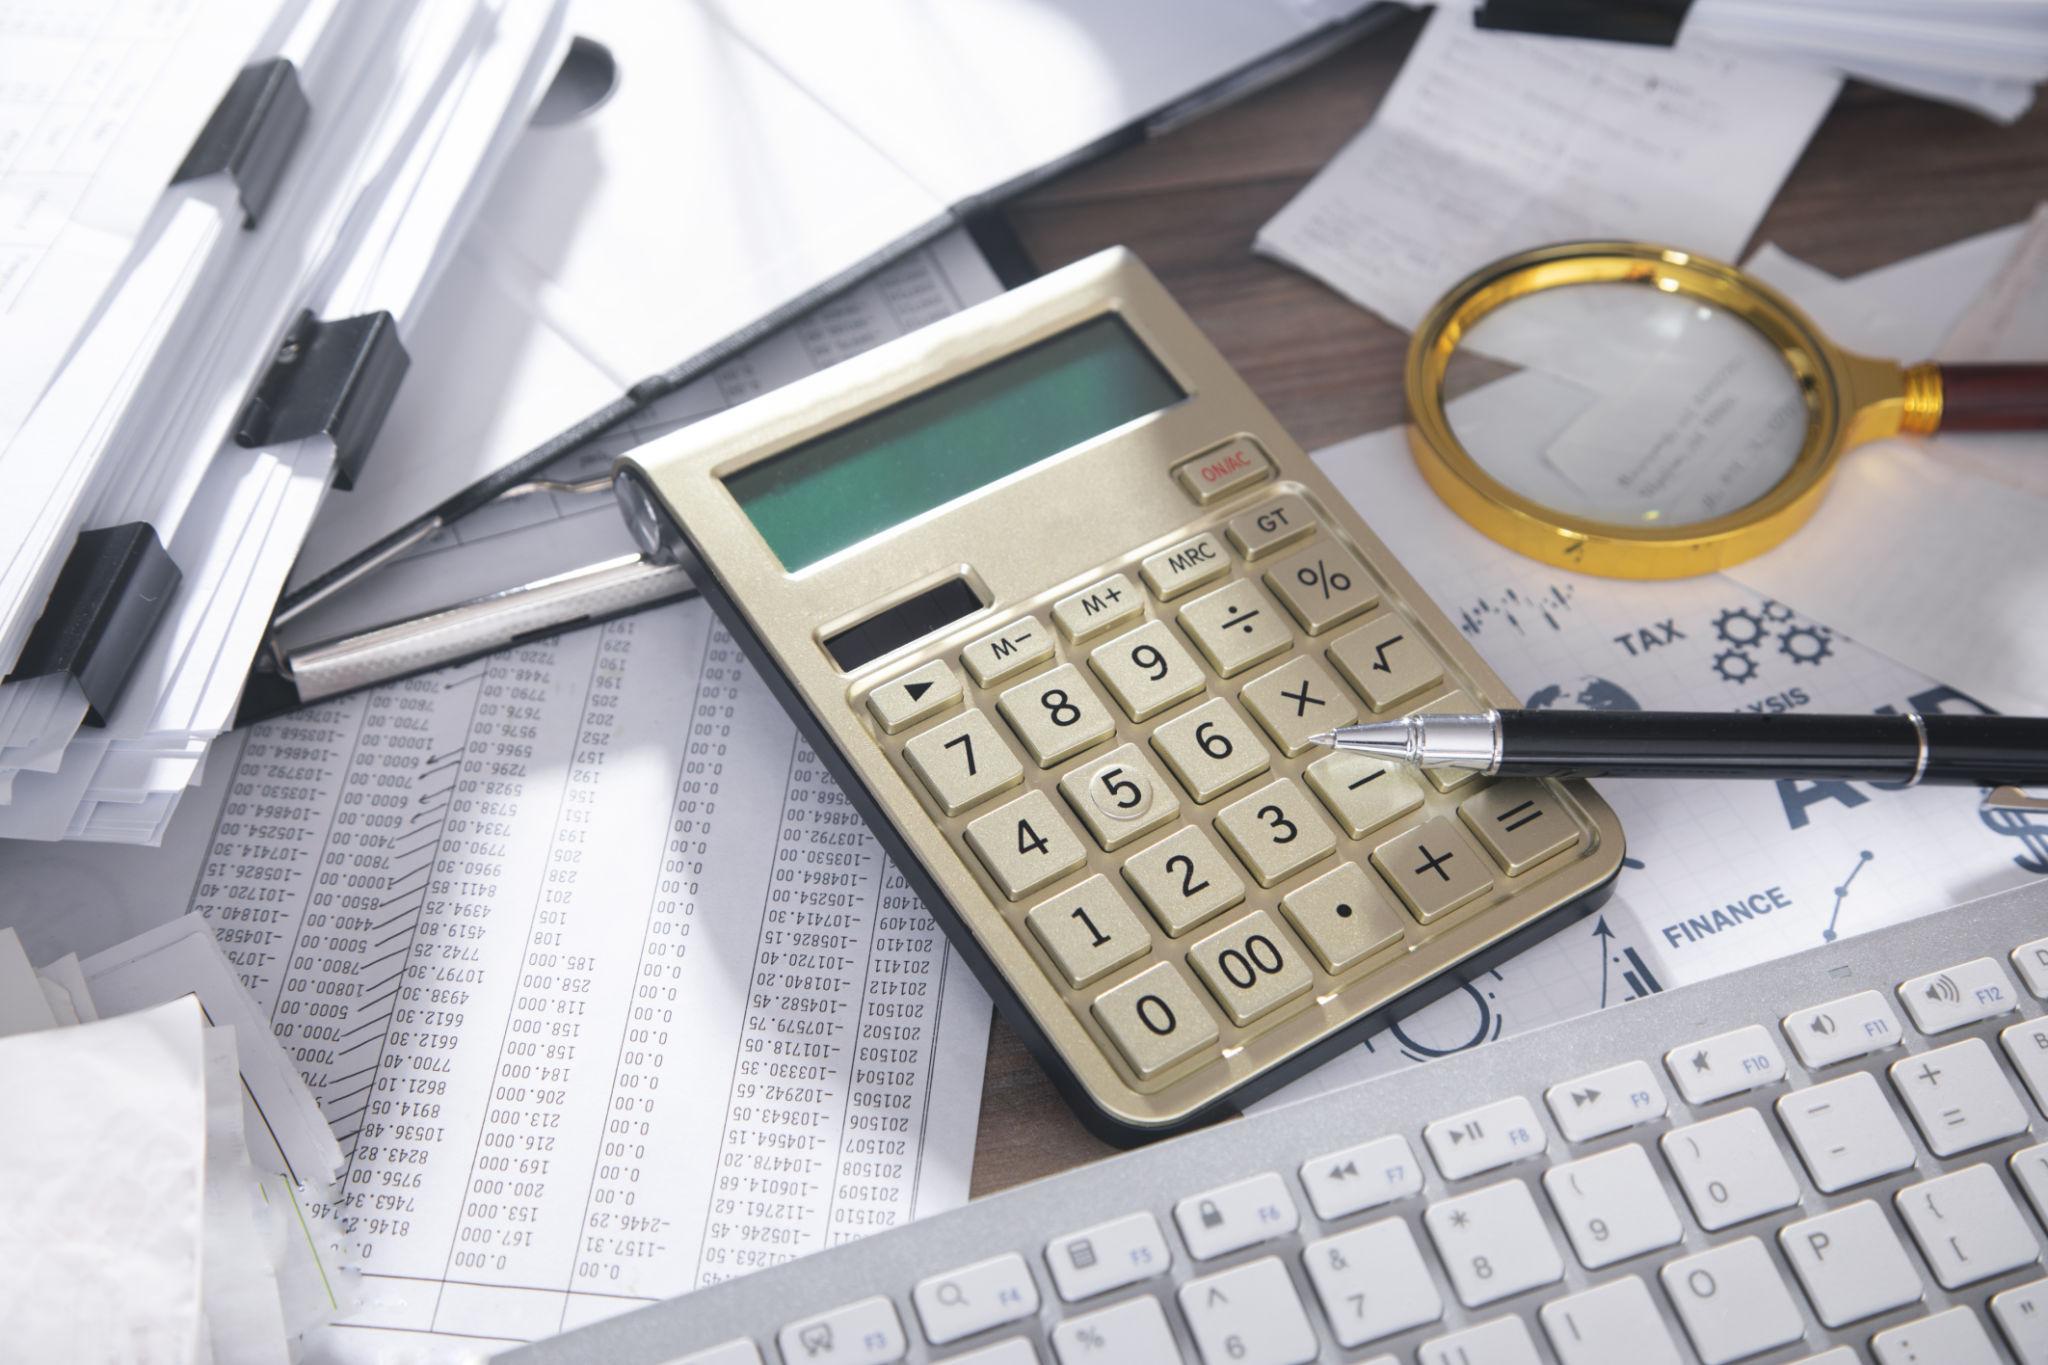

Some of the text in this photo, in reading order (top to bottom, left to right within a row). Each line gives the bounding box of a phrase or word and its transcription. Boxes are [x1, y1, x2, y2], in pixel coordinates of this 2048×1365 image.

[1200, 451, 1251, 484] ON/AC
[1256, 509, 1288, 533] GT
[1168, 542, 1216, 574] MRC
[1297, 560, 1351, 599] %
[1081, 586, 1122, 616] M+
[1614, 619, 1688, 658] TAX
[1131, 644, 1168, 681] 9
[1040, 689, 1082, 727] 8
[694, 723, 730, 737] 0.00
[1196, 722, 1233, 760] 6
[943, 734, 978, 777] 7
[1100, 768, 1142, 809] 5
[678, 800, 715, 814] 0.00
[1257, 805, 1298, 843] 3
[1017, 819, 1049, 854] 4
[670, 839, 706, 854] 0.00
[780, 849, 871, 866] -103530.00
[776, 869, 867, 887] -104864.00
[1165, 854, 1209, 897] 2
[431, 880, 497, 897] 8411.85
[773, 890, 864, 908] -105254.00
[426, 902, 491, 918] 4394.25
[769, 910, 861, 928] -107414.30
[1662, 886, 1793, 949] FINANCE
[307, 914, 373, 932] 4400.00
[420, 922, 486, 938] 4519.80
[653, 921, 689, 936] 0.00
[880, 917, 935, 931] 201409
[1070, 907, 1111, 947] 1
[300, 935, 367, 953] 5000.00
[765, 931, 857, 949] -105826.15
[877, 938, 933, 952] 201410
[415, 944, 479, 961] 7742.25
[761, 951, 854, 970] -101720.40
[1218, 934, 1284, 988] 00
[294, 956, 360, 975] 7800.00
[528, 953, 596, 971] 185.000
[874, 959, 930, 974] 201411
[408, 965, 485, 983] 10797.30
[757, 973, 850, 992] -101840.20
[287, 978, 364, 997] 10800.00
[523, 975, 591, 993] 258.000
[870, 981, 927, 995] 201412
[402, 987, 470, 1004] 4938.30
[753, 994, 847, 1013] -104582.45
[1976, 986, 2004, 1005] F12
[280, 1000, 348, 1019] 5000.00
[518, 997, 586, 1014] 118.000
[868, 1002, 923, 1018] 201501
[396, 1009, 464, 1027] 6612.30
[1136, 994, 1176, 1036] 0
[274, 1023, 341, 1041] 7000.00
[512, 1019, 581, 1037] 158.000
[749, 1016, 844, 1035] -107579.75
[863, 1024, 921, 1040] 201502
[1864, 1020, 1888, 1036] F11
[390, 1032, 458, 1049] 6612.30
[629, 1029, 668, 1045] 0.00
[507, 1041, 576, 1059] 158.000
[745, 1039, 840, 1058] -101718.05
[860, 1048, 918, 1063] 201503
[383, 1054, 450, 1072] 7700.40
[741, 1061, 837, 1081] -103330.35
[1743, 1055, 1770, 1073] F10
[501, 1064, 571, 1082] 184.000
[856, 1070, 915, 1086] 201504
[378, 1078, 446, 1095] 8621.10
[737, 1083, 833, 1103] -102942.65
[496, 1087, 566, 1105] 206.000
[615, 1096, 654, 1113] 0.00
[853, 1093, 912, 1109] 201505
[1630, 1090, 1651, 1108] F9
[372, 1101, 440, 1118] 8914.05
[732, 1106, 829, 1126] -103643.05
[491, 1110, 560, 1128] 213.000
[850, 1115, 909, 1132] 201506
[364, 1123, 445, 1142] 10536.48
[729, 1130, 826, 1150] -104564.15
[1509, 1127, 1530, 1146] F8
[485, 1133, 555, 1151] 216.000
[846, 1139, 905, 1155] 201507
[358, 1146, 428, 1164] 8243.82
[724, 1152, 822, 1172] -104478.20
[479, 1156, 550, 1174] 169.000
[842, 1162, 902, 1178] 201508
[352, 1169, 422, 1188] 9756.00
[1386, 1166, 1405, 1184] F7
[473, 1179, 544, 1198] 200.000
[719, 1176, 819, 1196] -106014.68
[839, 1185, 899, 1202] 201509
[346, 1193, 415, 1212] 7463.34
[595, 1189, 635, 1205] 0.00
[467, 1203, 539, 1222] 153.000
[715, 1198, 815, 1220] -112761.62
[835, 1208, 896, 1225] 201510
[1258, 1205, 1280, 1223] F6
[590, 1213, 670, 1233] -2446.29
[1589, 1219, 1609, 1241] 9
[461, 1227, 533, 1247] 167.000
[711, 1223, 811, 1244] -105246.45
[586, 1237, 665, 1257] -1157.31
[1808, 1232, 1831, 1260] P
[455, 1251, 507, 1270] 0.000
[1130, 1248, 1152, 1266] F5
[1329, 1249, 1348, 1270] &
[579, 1262, 620, 1280] 0.00
[1472, 1256, 1492, 1279] 8
[1000, 1288, 1020, 1307] F4
[1348, 1294, 1366, 1319] 7
[864, 1331, 887, 1350] F3
[1225, 1335, 1245, 1359] 6
